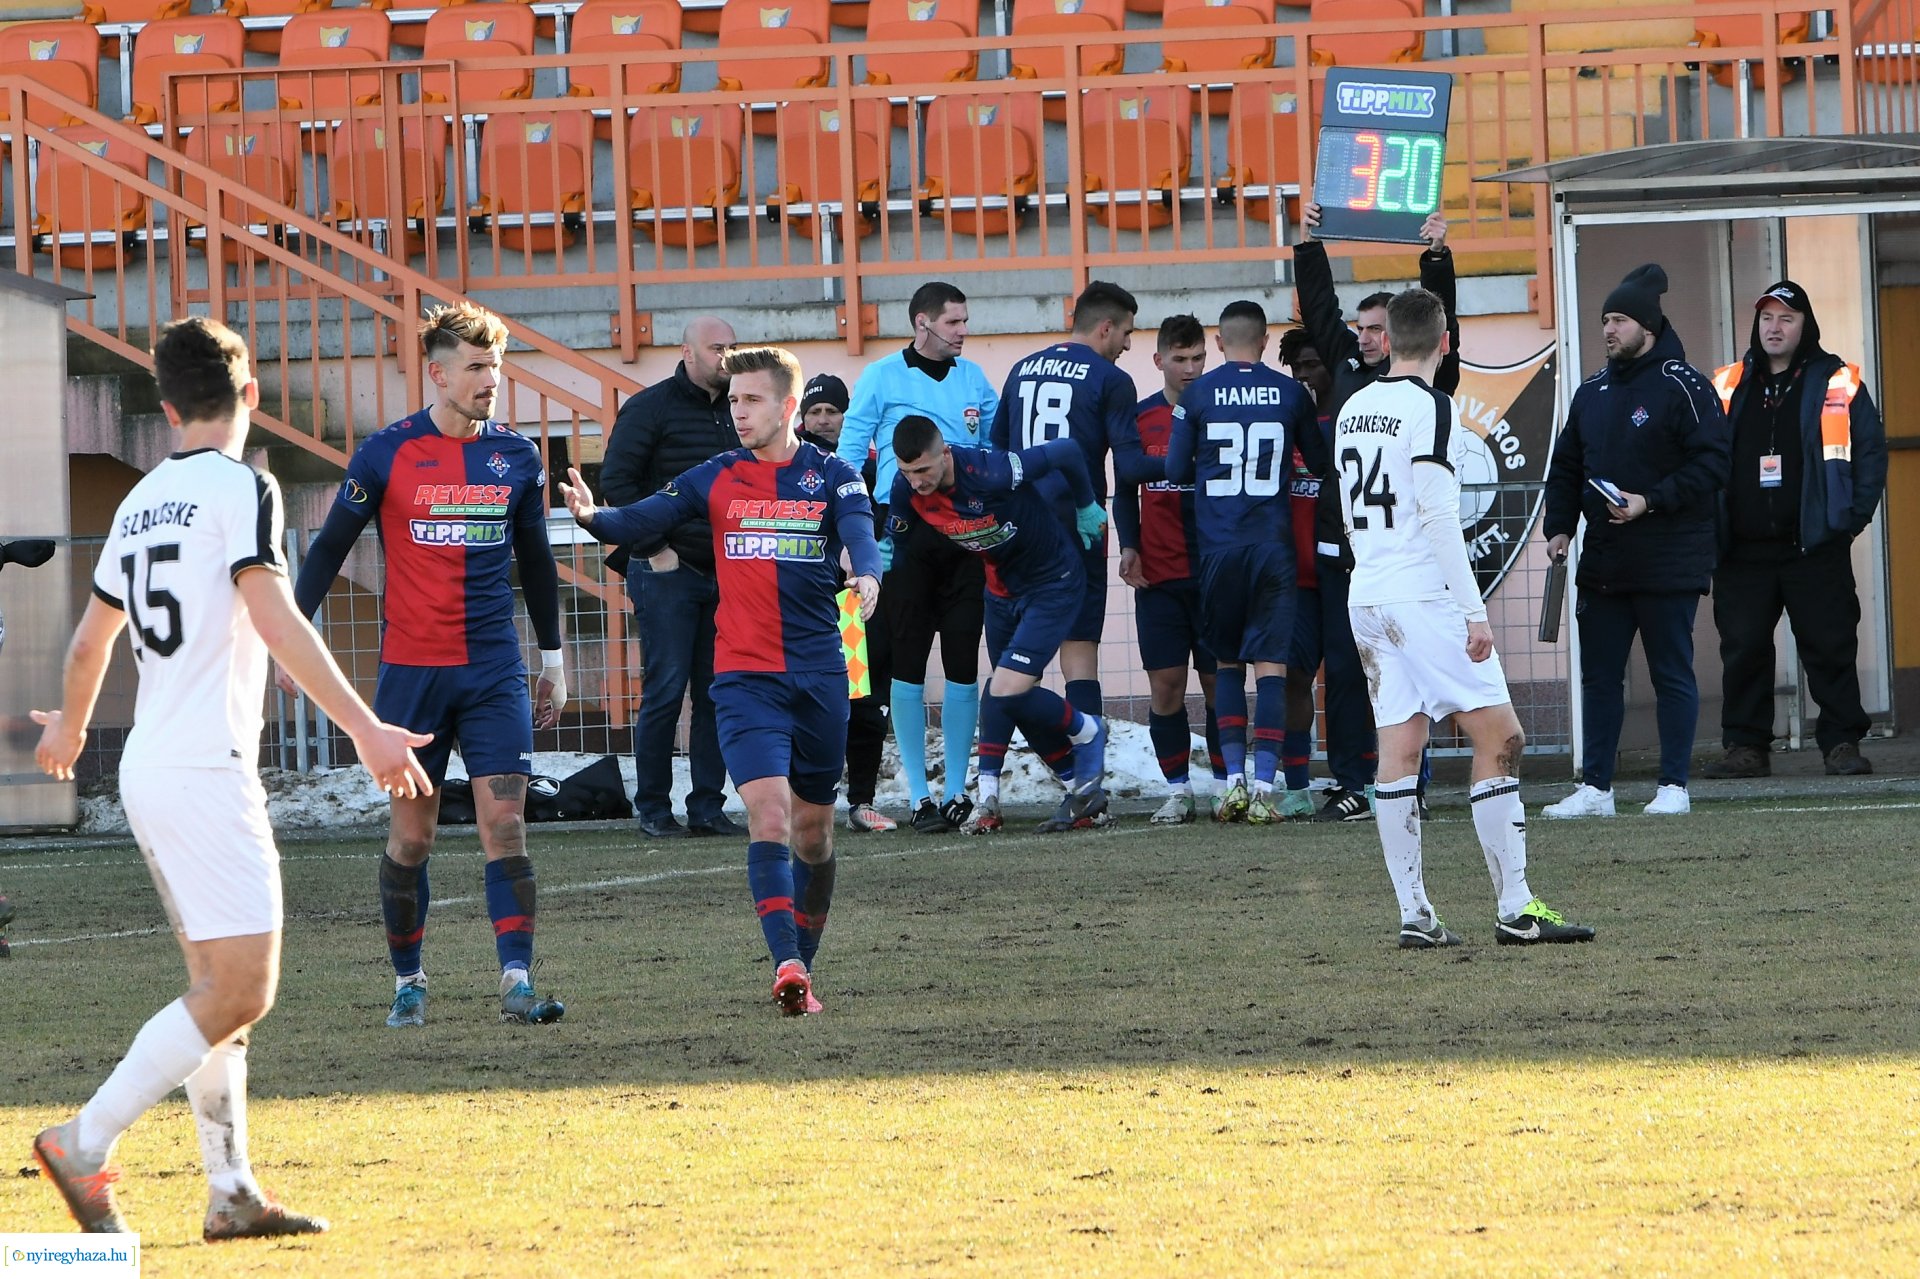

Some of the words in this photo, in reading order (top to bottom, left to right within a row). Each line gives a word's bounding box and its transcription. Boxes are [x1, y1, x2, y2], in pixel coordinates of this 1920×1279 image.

[1018, 356, 1091, 380] MÁRKUS
[1214, 387, 1281, 406] HAMED
[1018, 381, 1074, 451] 18
[1205, 421, 1285, 497] 30
[1340, 446, 1398, 531] 24
[120, 541, 185, 659] 15
